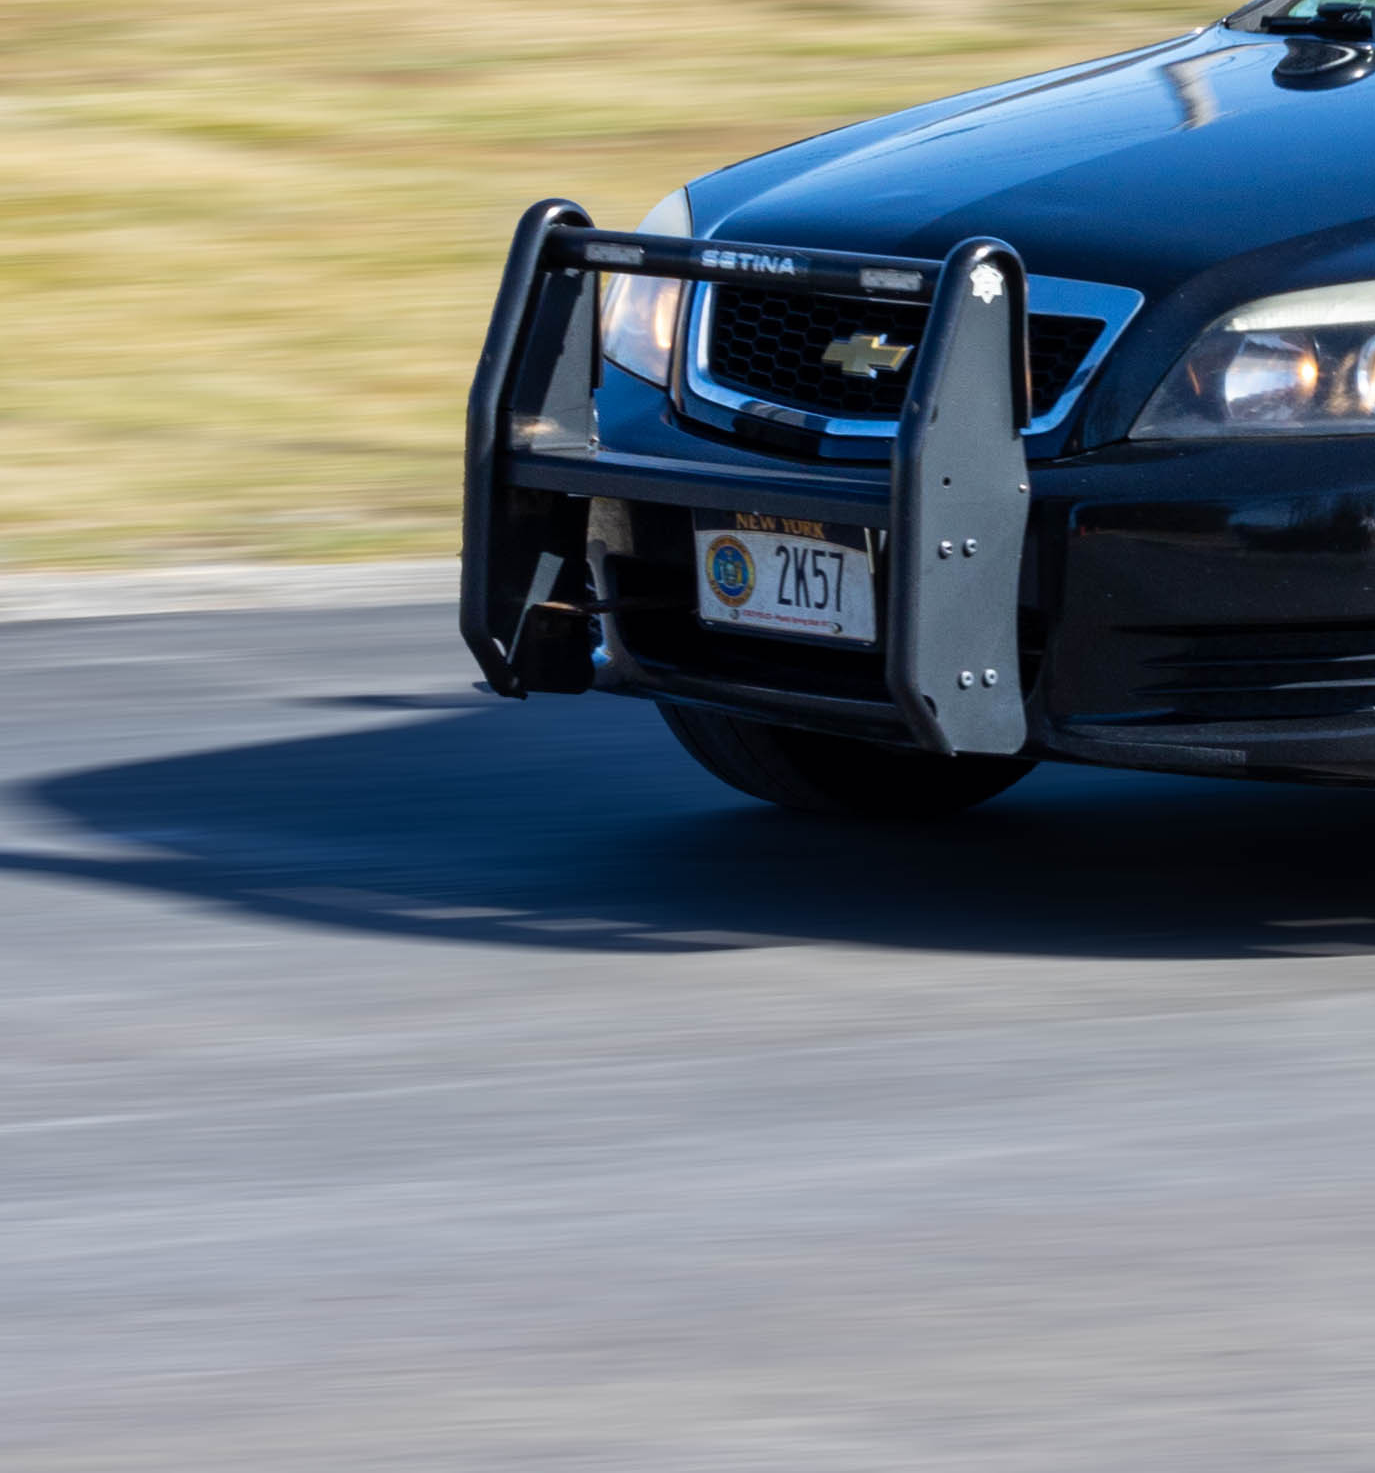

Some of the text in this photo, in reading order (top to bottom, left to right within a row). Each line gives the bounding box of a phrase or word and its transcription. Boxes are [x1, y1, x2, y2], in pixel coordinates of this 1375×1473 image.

[701, 250, 796, 275] SETINA
[737, 513, 826, 539] NEW YORK
[775, 546, 844, 612] 2K57
